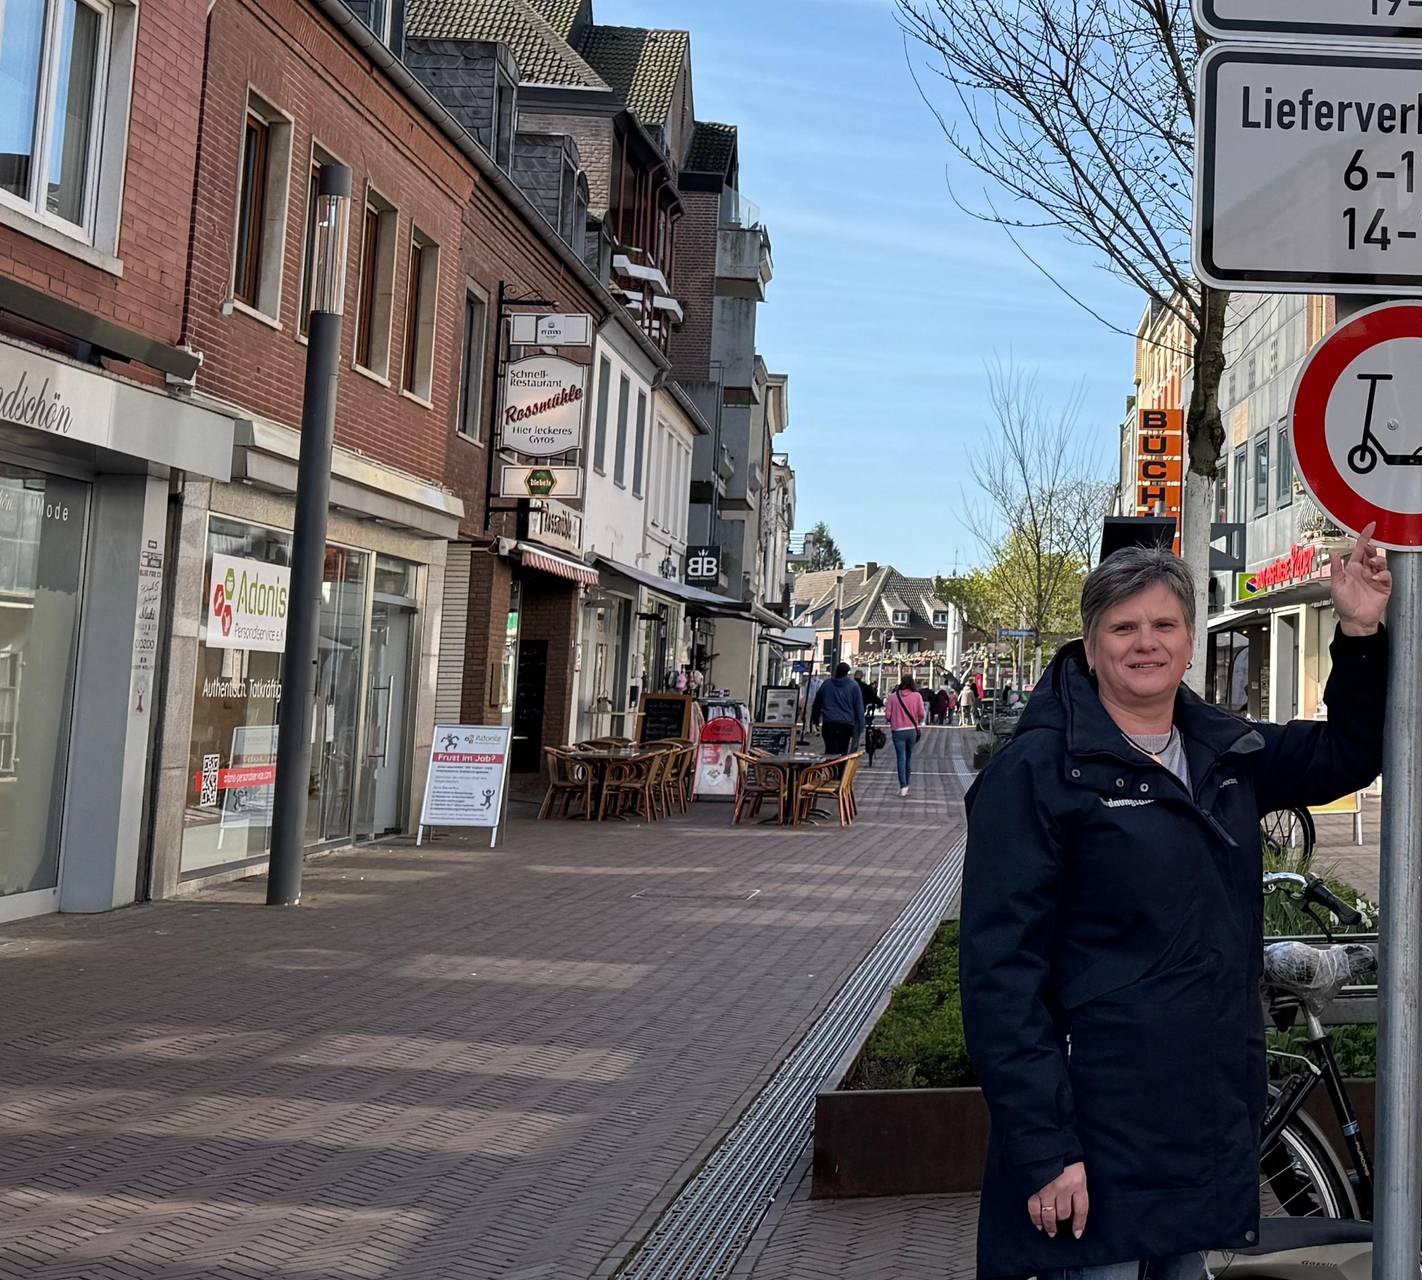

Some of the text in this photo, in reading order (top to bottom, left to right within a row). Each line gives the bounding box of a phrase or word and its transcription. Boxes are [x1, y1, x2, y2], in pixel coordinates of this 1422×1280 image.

[510, 379, 562, 388] Restaurant
[0, 371, 73, 434] dschön
[528, 434, 555, 444] Gyros
[1142, 411, 1168, 517] BÜCH
[236, 570, 287, 619] Adonis
[437, 753, 496, 763] Frust im Job?
